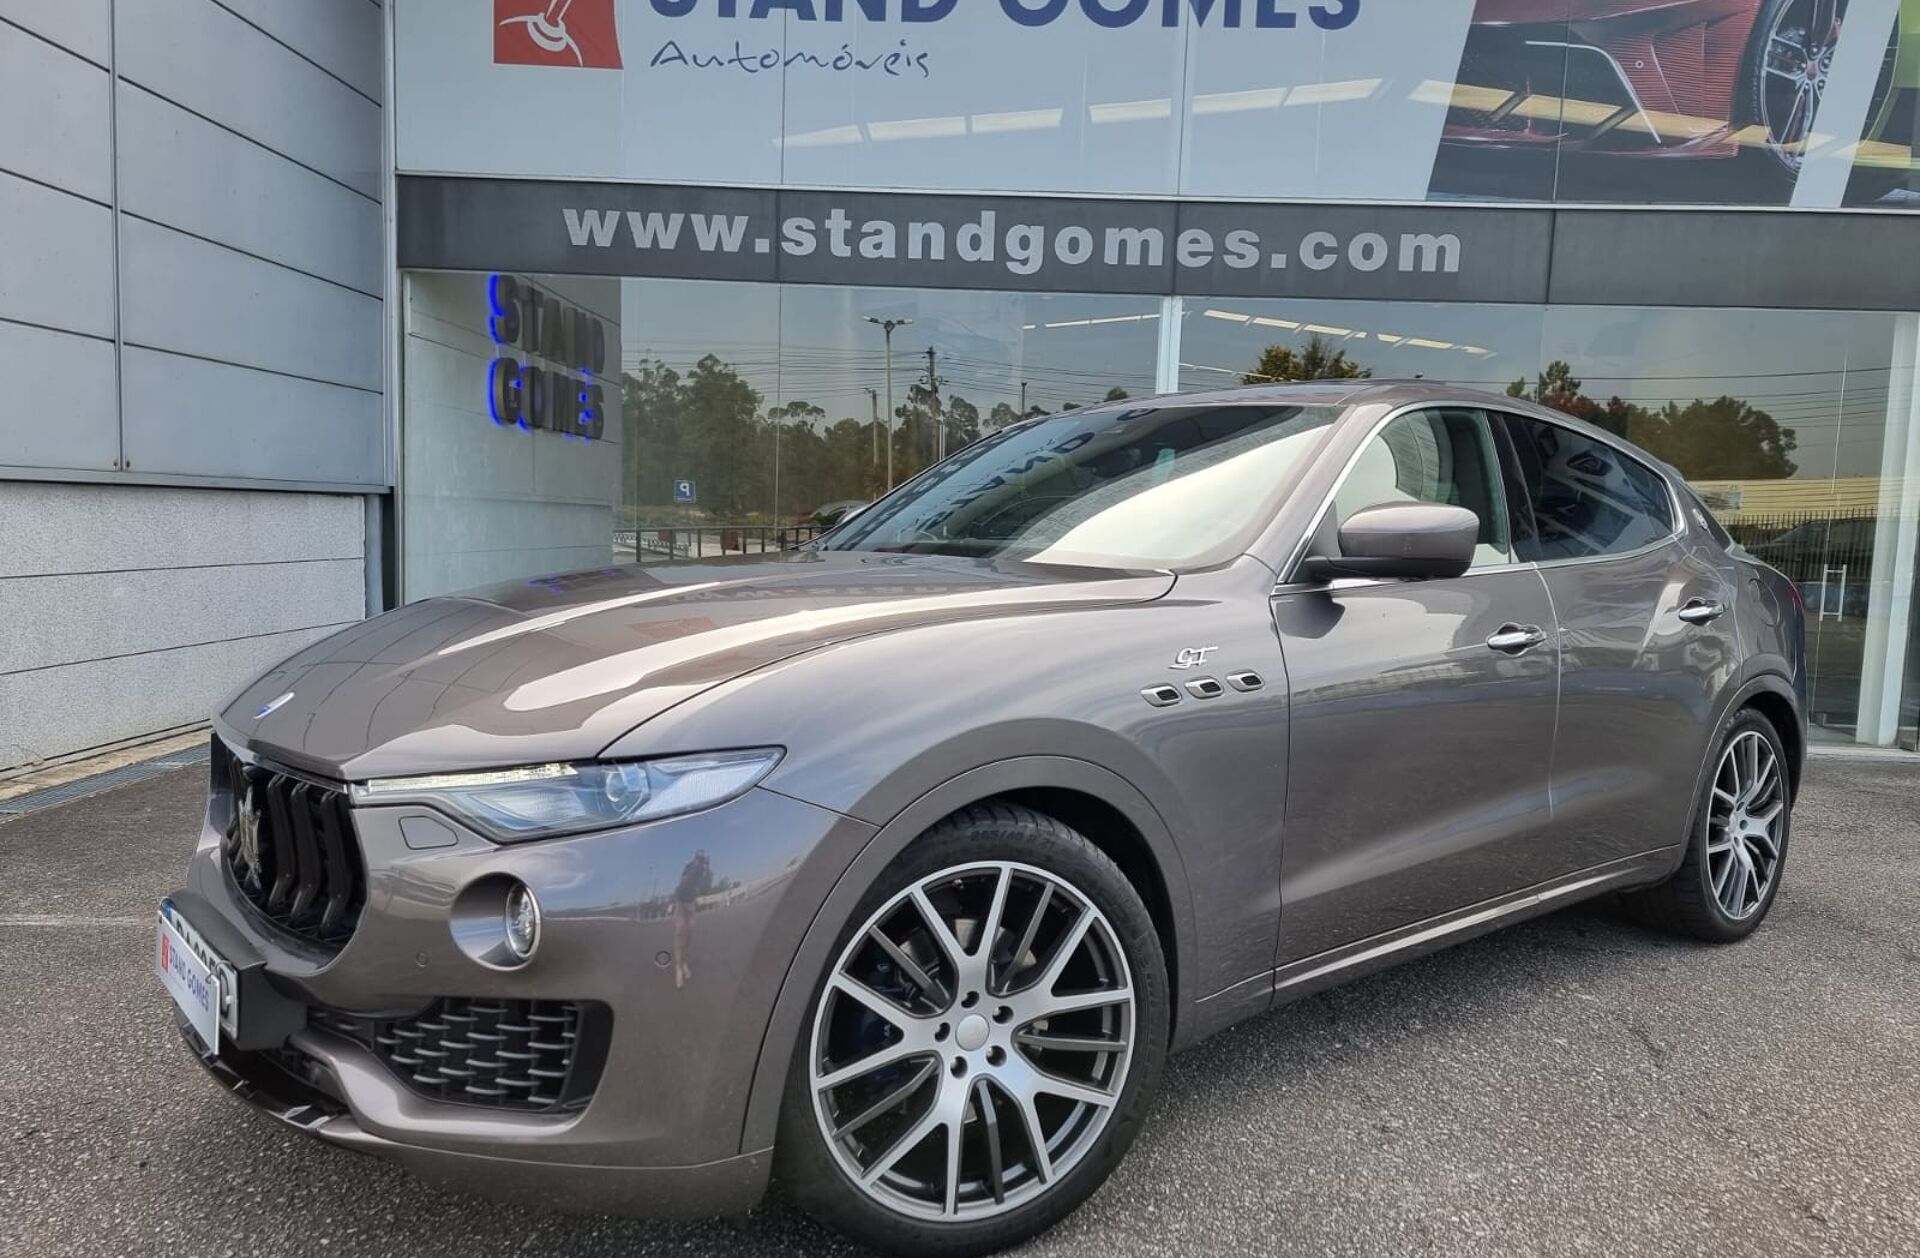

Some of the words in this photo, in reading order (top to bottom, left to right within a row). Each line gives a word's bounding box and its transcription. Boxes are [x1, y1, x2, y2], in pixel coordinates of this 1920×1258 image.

[650, 40, 929, 78] Automóveis
[562, 208, 1461, 275] www.standgomes.com
[1168, 646, 1219, 670] GT
